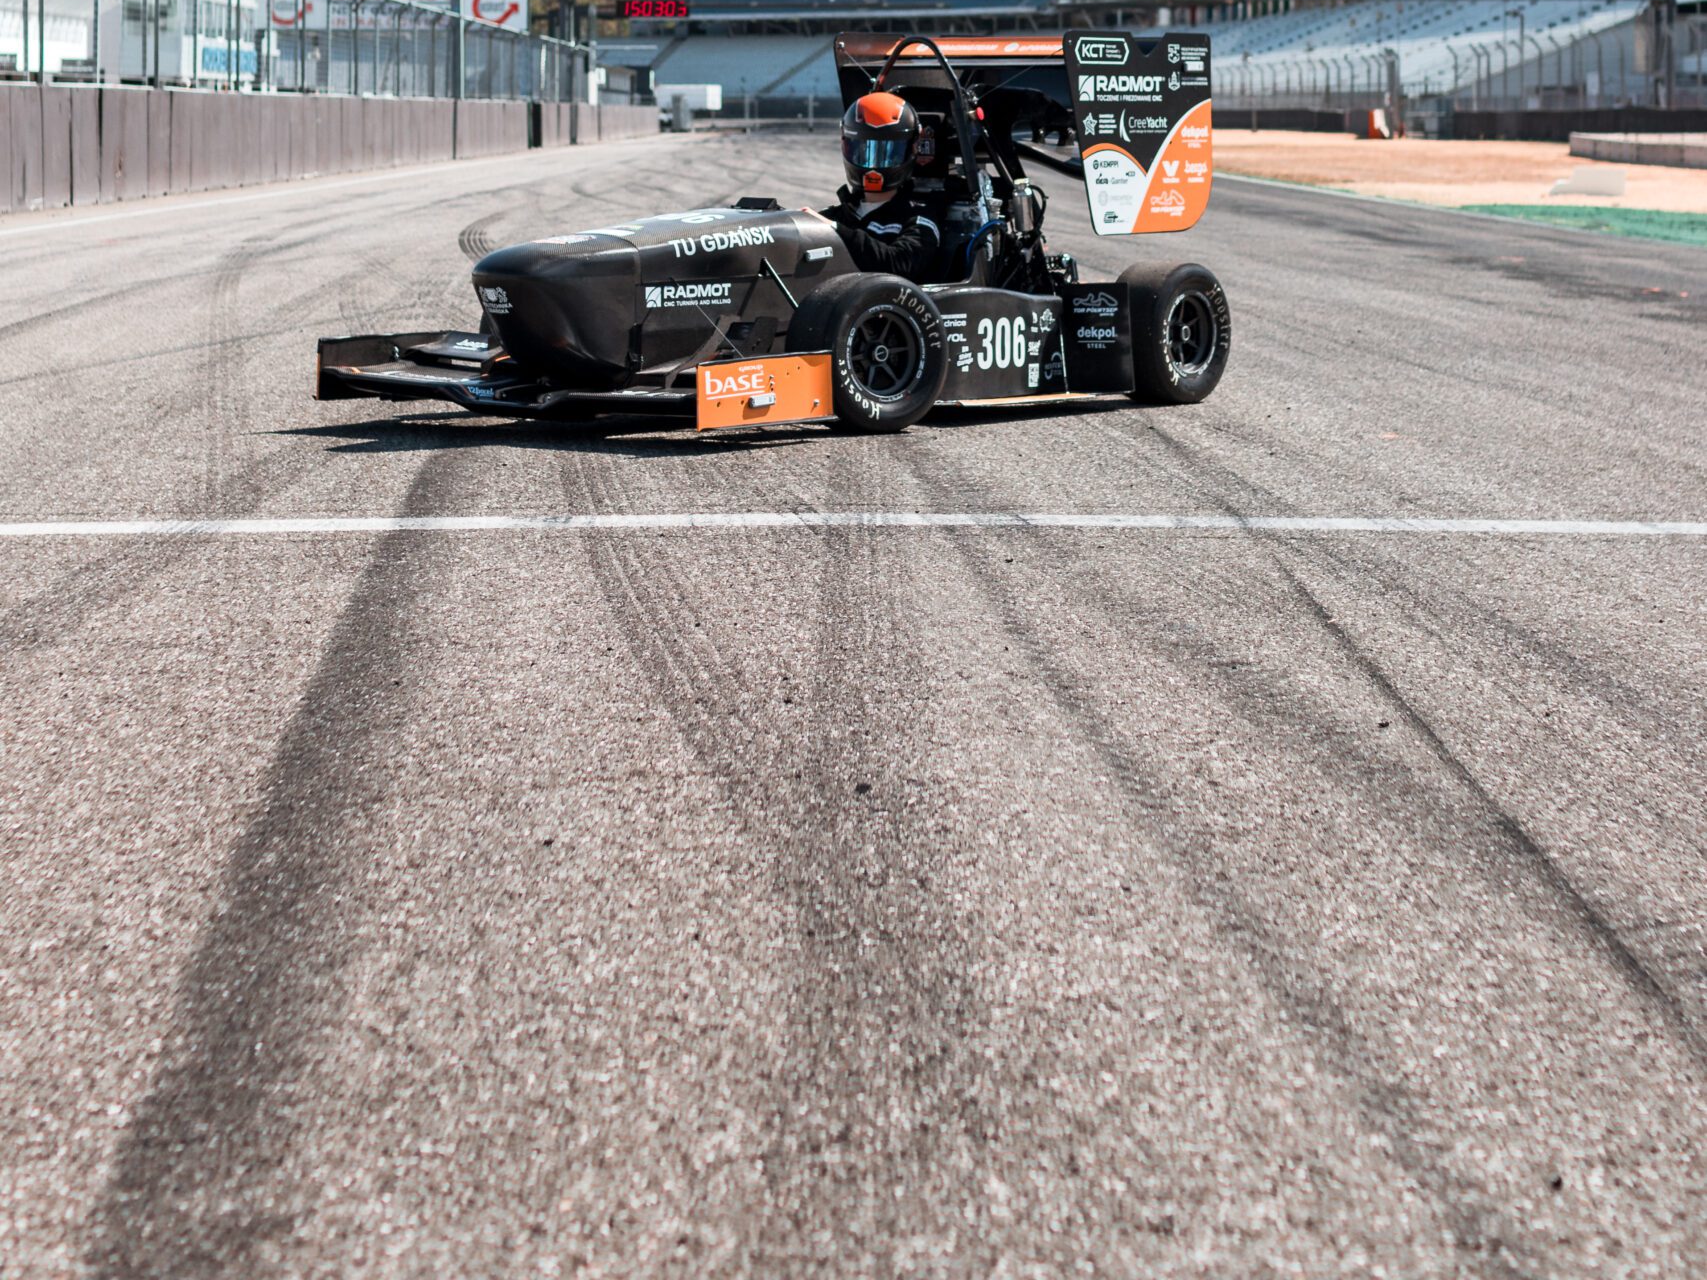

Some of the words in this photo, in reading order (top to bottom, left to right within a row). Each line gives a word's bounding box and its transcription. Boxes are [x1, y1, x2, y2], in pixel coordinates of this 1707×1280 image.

[1082, 43, 1105, 58] KCT
[1096, 75, 1162, 92] RADMOT
[1128, 116, 1168, 128] CreeYacht
[667, 237, 697, 258] TU
[700, 225, 775, 253] GDAŃSK
[663, 283, 732, 299] RADMOT
[892, 287, 941, 349] Hoosier
[1077, 326, 1115, 340] dekpol
[977, 316, 1026, 370] 306
